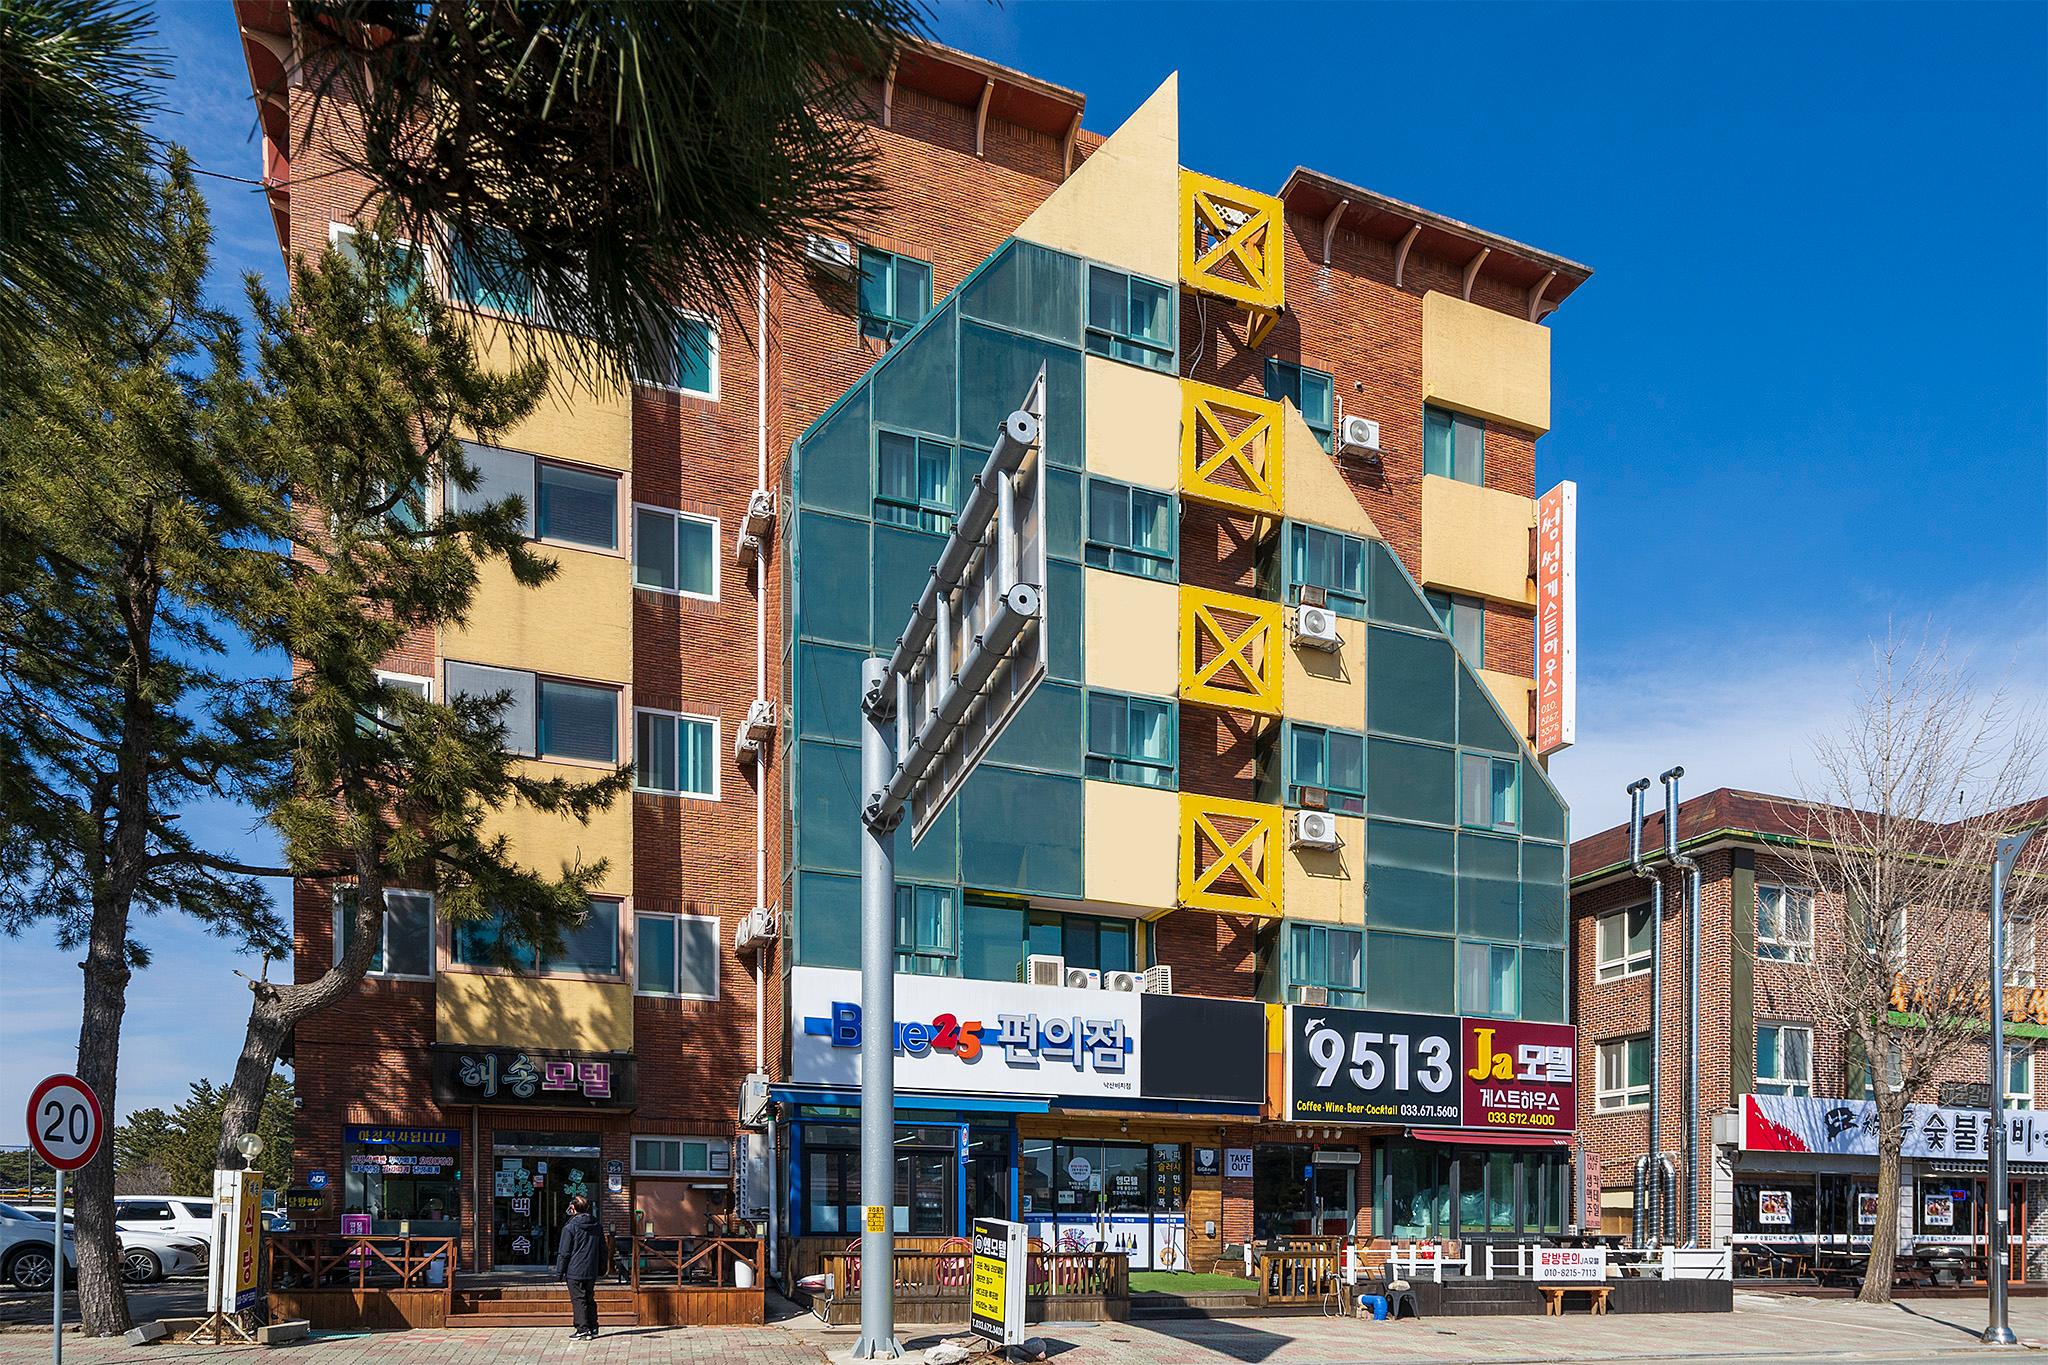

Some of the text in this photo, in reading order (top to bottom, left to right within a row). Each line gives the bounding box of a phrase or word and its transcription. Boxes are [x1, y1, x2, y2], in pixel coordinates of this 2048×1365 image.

[1543, 577, 1558, 699] 게스트하우스
[831, 1001, 1127, 1071] Be25 편의점
[1308, 1028, 1453, 1093] 9513
[1468, 1028, 1573, 1083] Ja 모텔
[1103, 1081, 1132, 1090] 낙산비치점
[1480, 1088, 1560, 1111] 게스트하우스
[1400, 1104, 1458, 1118] 033.671.5600
[43, 1101, 89, 1145] 20
[1488, 1111, 1555, 1126] 033.672.4000
[1230, 1154, 1251, 1163] TAKE
[1587, 1154, 1598, 1162] TAKE
[1157, 1162, 1180, 1172] 슬러시
[1231, 1163, 1249, 1171] OUT
[1587, 1162, 1597, 1171] OUT
[310, 1175, 326, 1183] ADT
[242, 1203, 255, 1284] 식당
[983, 1237, 1007, 1259] 엠모텔
[1541, 1253, 1580, 1265] 달방문의
[1544, 1268, 1597, 1277] 010-8215-7113
